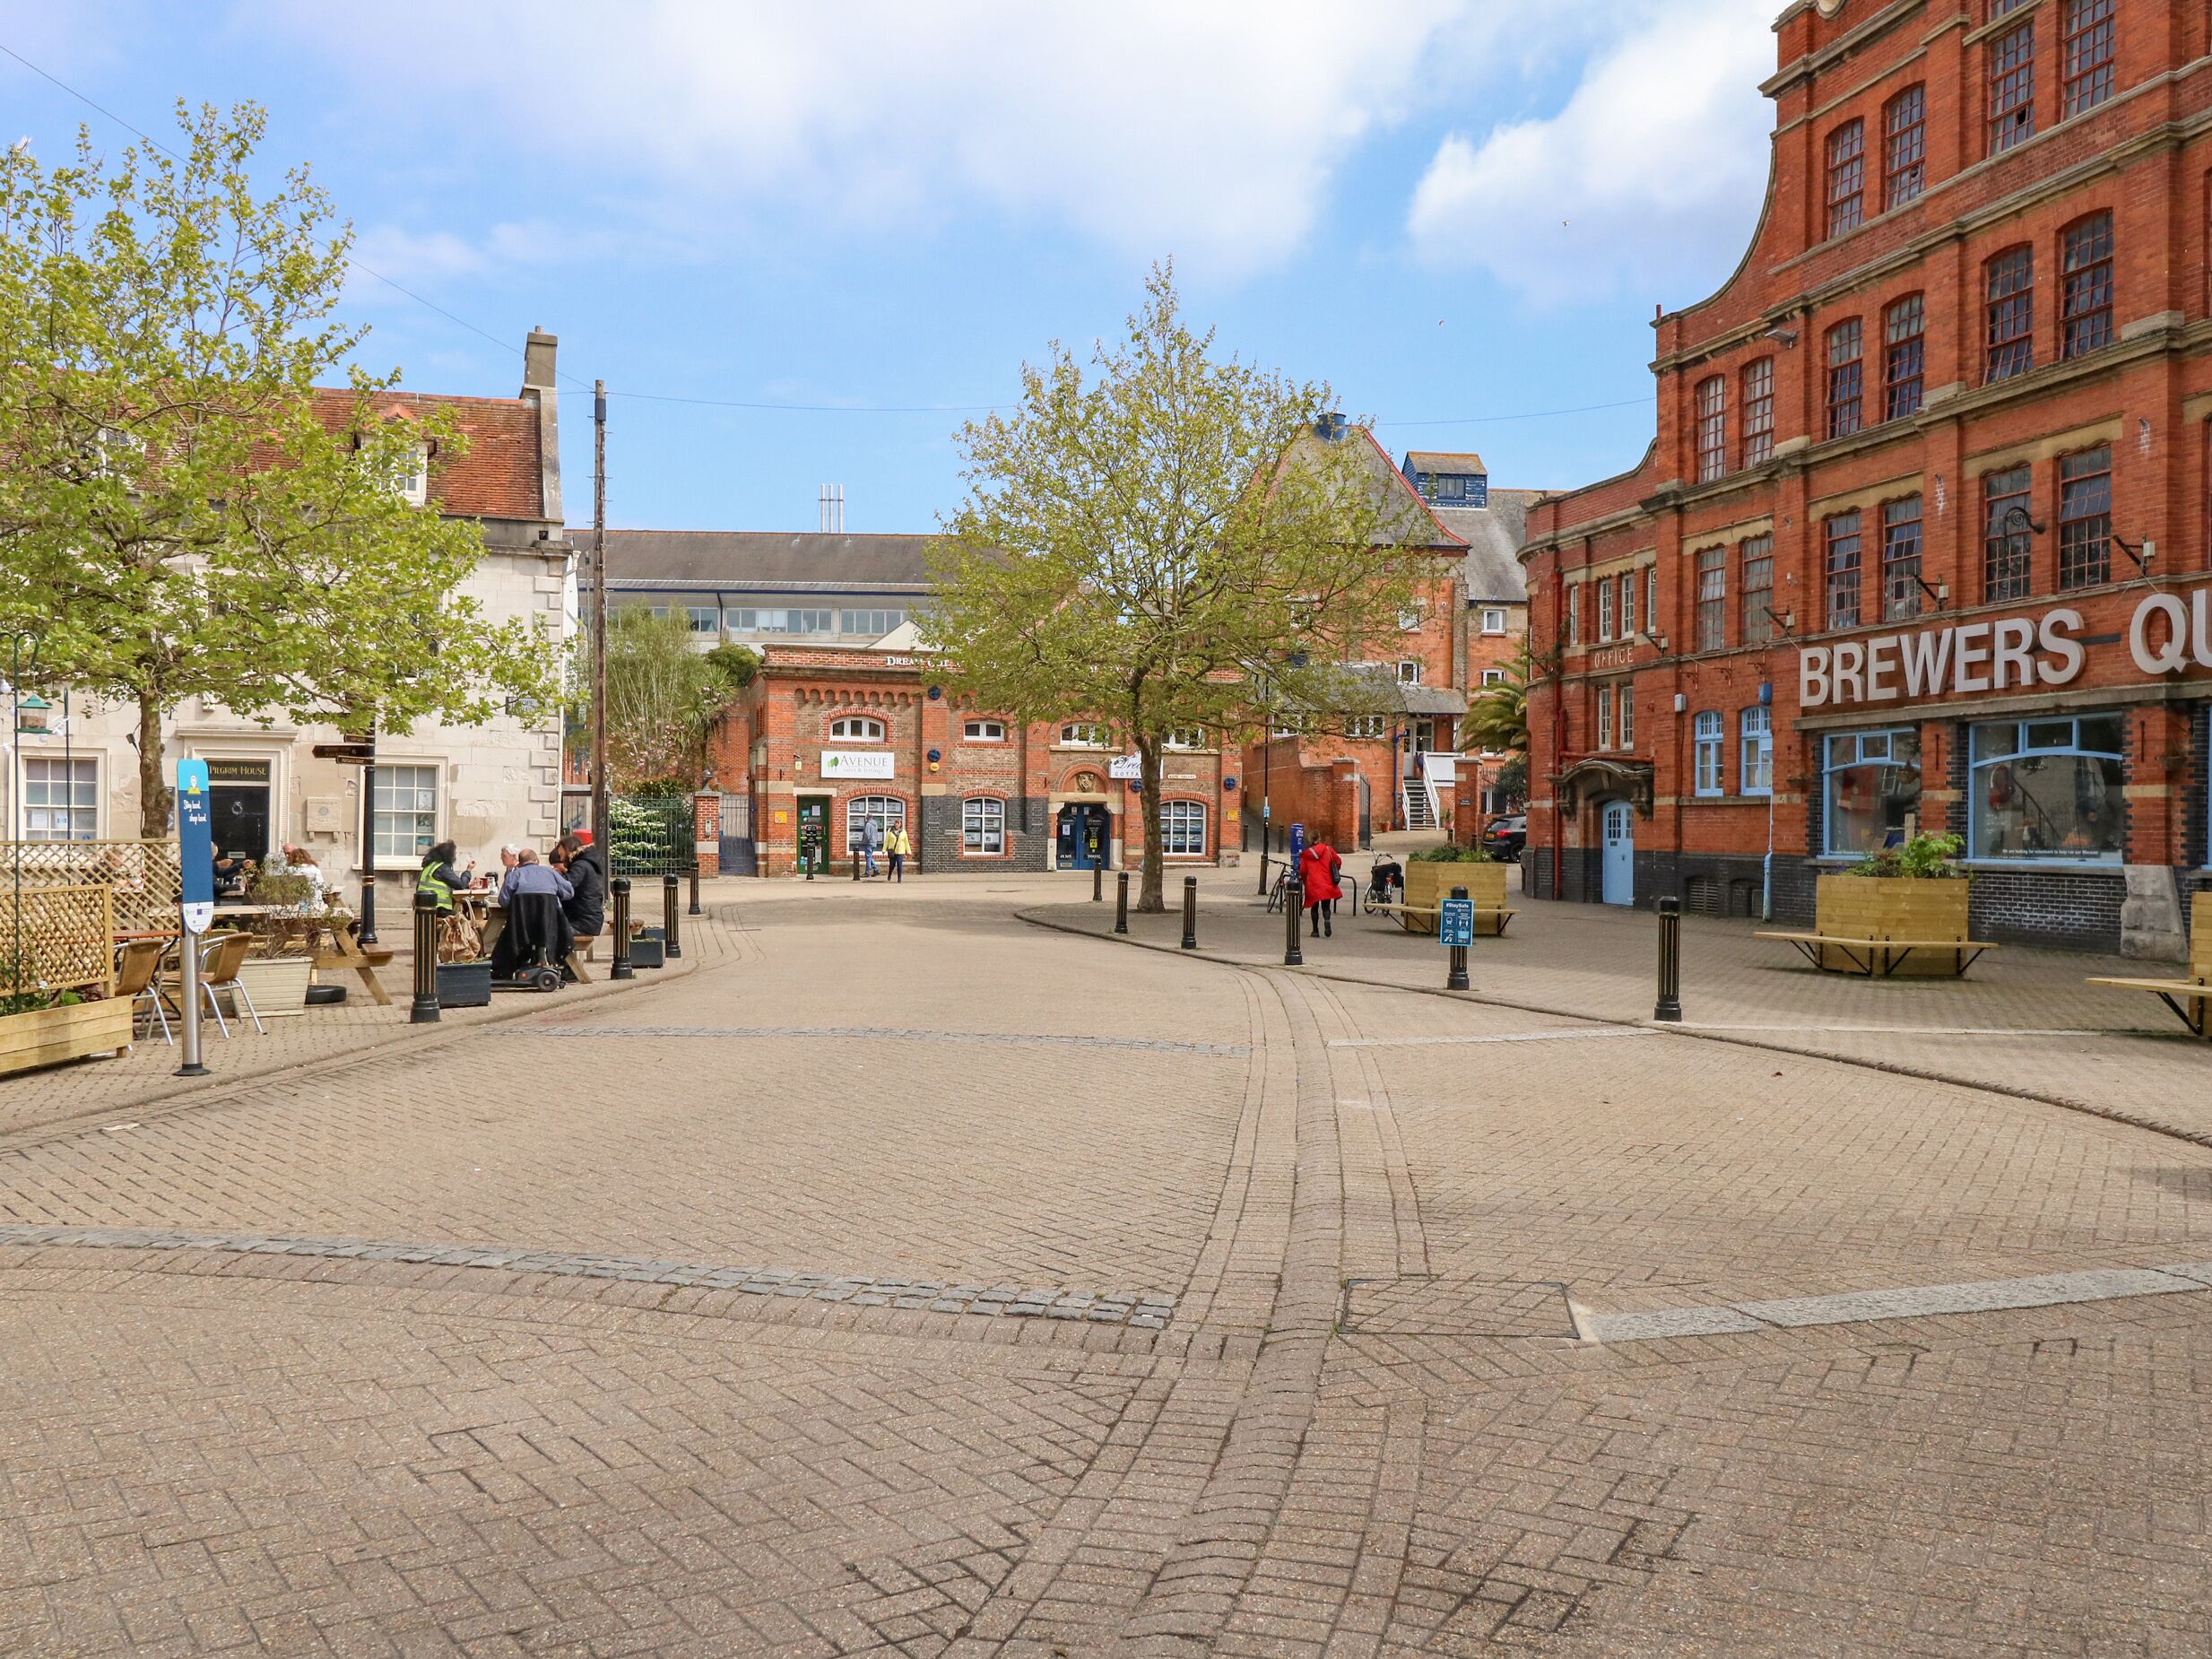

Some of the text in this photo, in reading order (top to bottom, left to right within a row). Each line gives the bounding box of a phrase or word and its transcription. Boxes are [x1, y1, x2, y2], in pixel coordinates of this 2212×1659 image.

[1594, 647, 1634, 668] OFFICE
[1800, 608, 2086, 708] BREWERS
[840, 755, 887, 767] AVENUE
[209, 765, 267, 776] PILGRIM HOUSE
